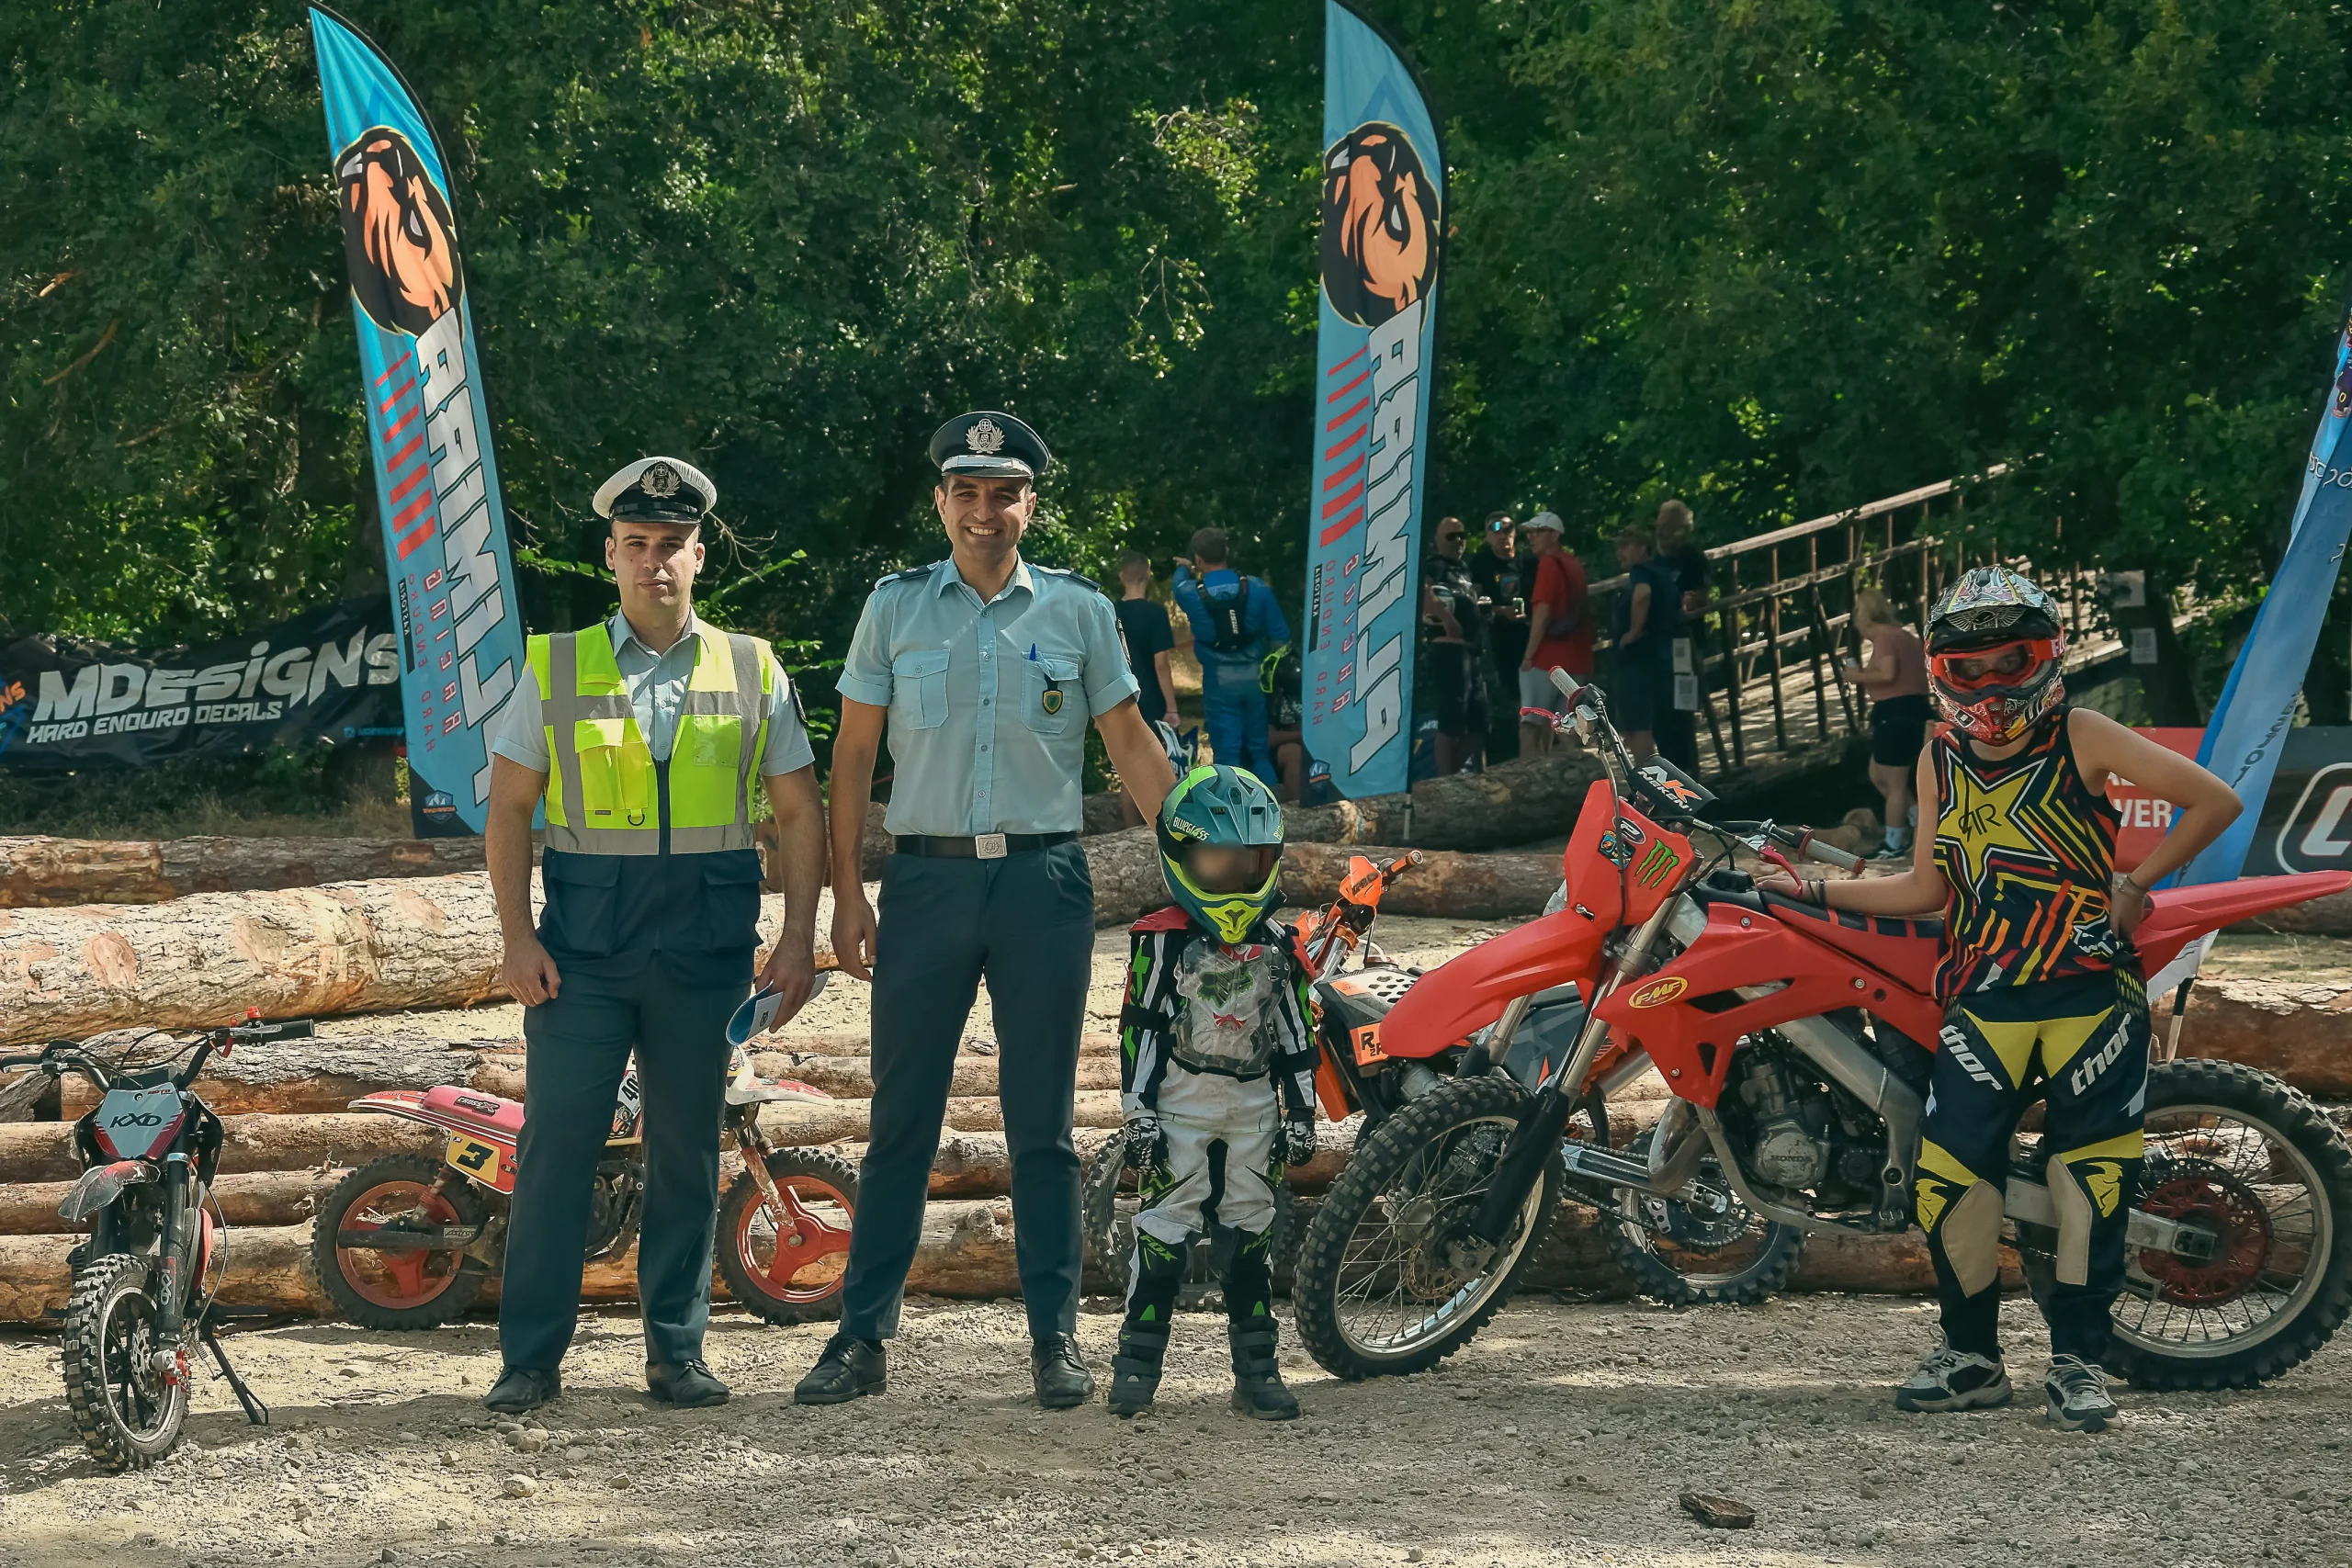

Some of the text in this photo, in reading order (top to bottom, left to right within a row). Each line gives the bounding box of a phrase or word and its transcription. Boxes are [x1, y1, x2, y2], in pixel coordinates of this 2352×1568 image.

[26, 701, 283, 744] HARD ENDURO DECALS
[1634, 980, 1682, 1006] FMF
[1939, 1024, 2003, 1090] thor
[2071, 1012, 2132, 1096] thor
[109, 1112, 163, 1128] KXD
[456, 1142, 494, 1171] 3
[1770, 1155, 1813, 1163] HONDA
[160, 1269, 173, 1305] KXD
